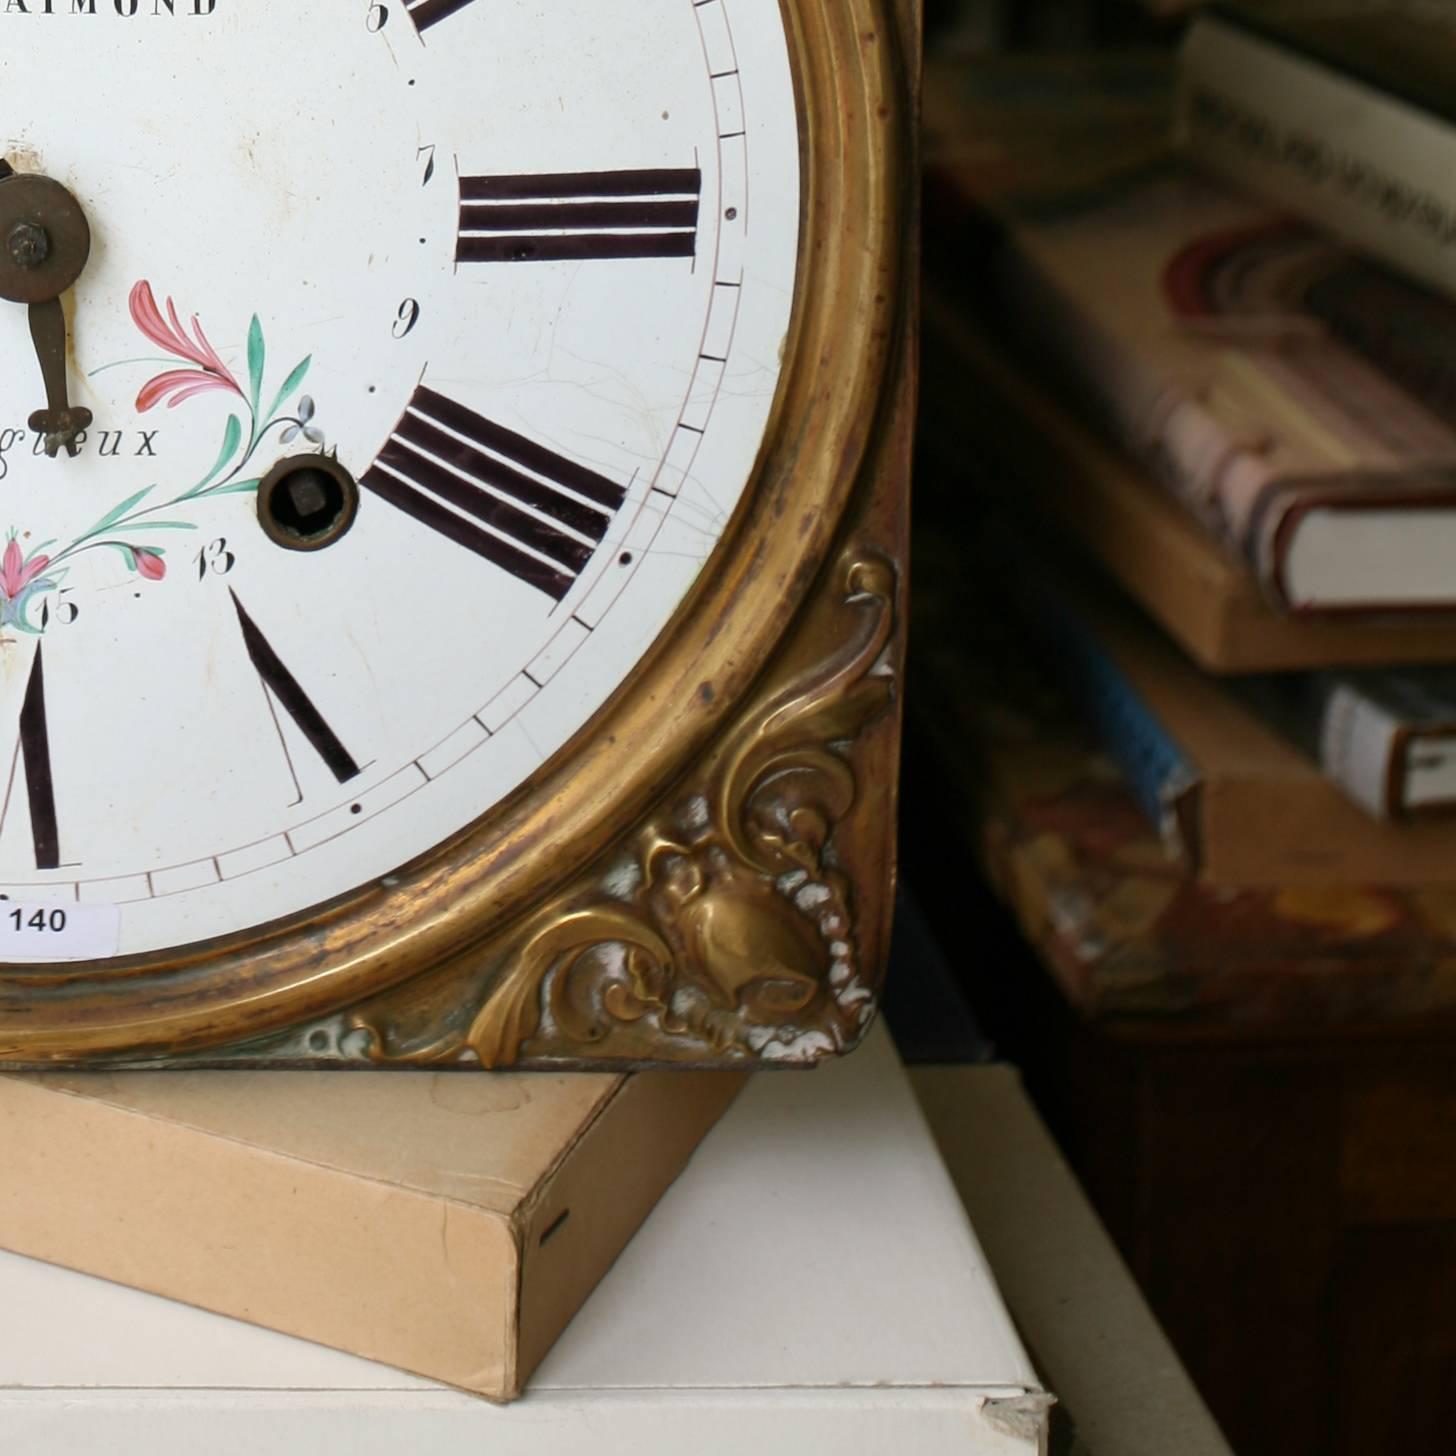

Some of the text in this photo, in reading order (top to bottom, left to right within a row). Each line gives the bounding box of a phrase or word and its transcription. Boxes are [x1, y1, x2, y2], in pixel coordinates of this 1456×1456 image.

[417, 144, 435, 186] 7
[453, 145, 702, 275] III
[391, 297, 421, 340] 9
[193, 536, 235, 583] 13
[9, 907, 67, 933] 140
